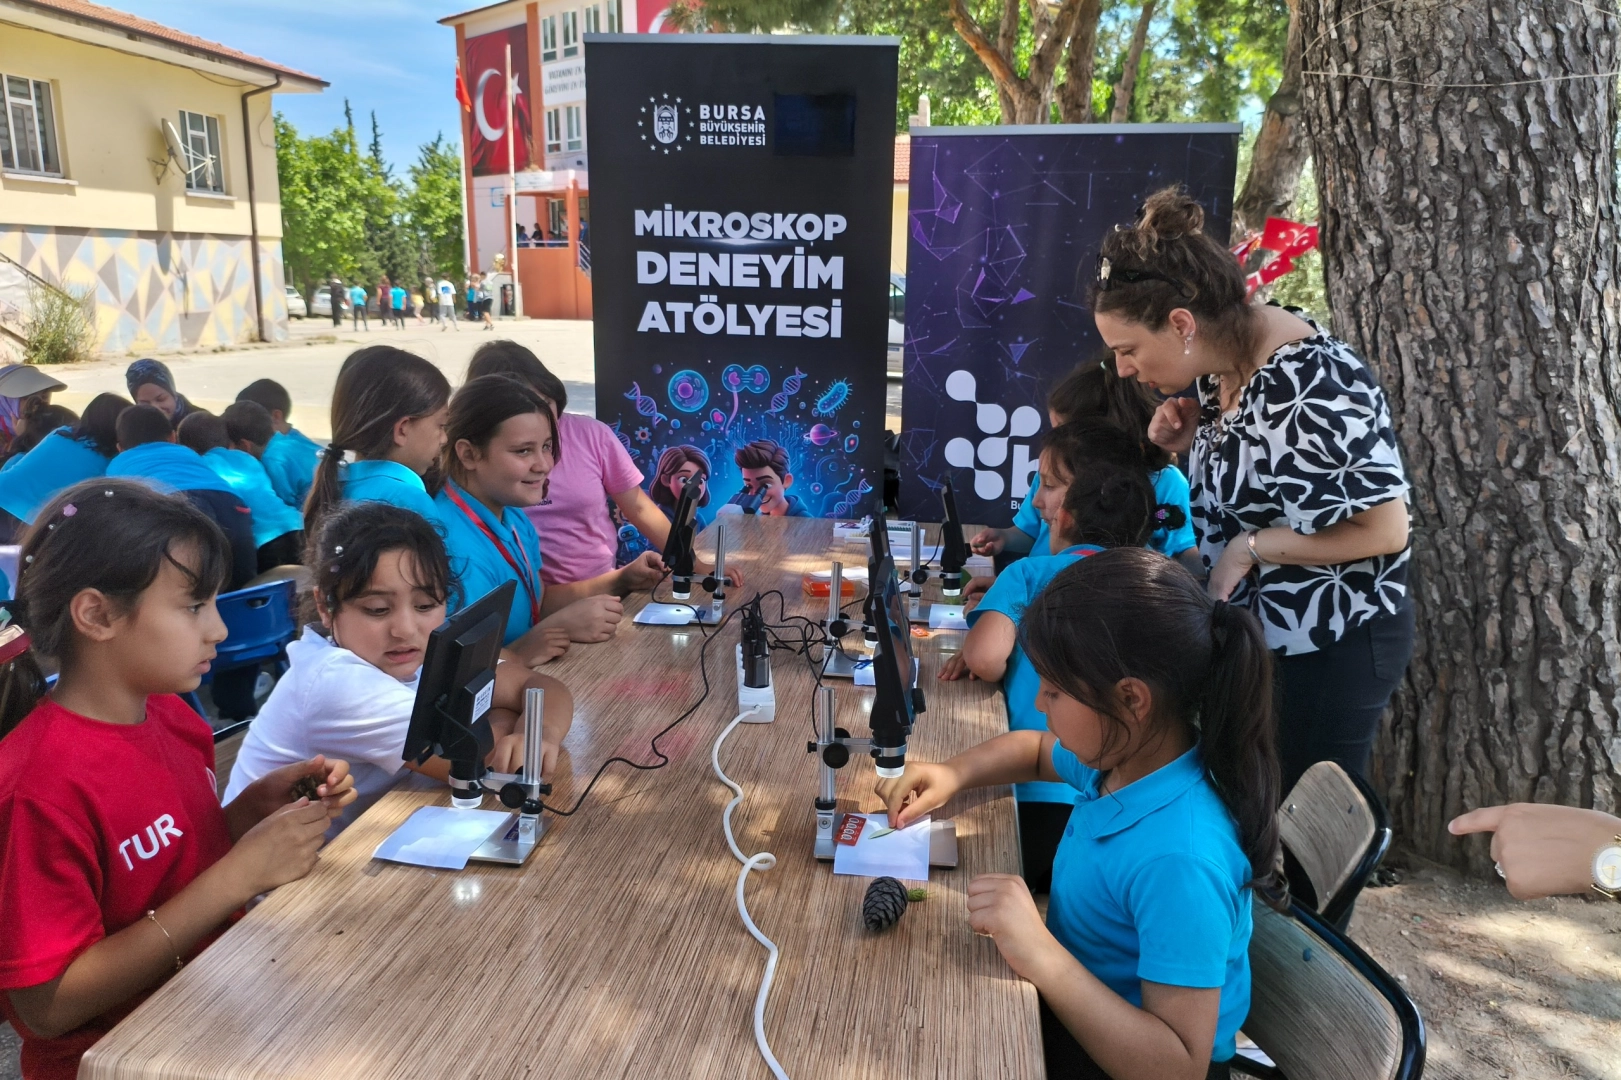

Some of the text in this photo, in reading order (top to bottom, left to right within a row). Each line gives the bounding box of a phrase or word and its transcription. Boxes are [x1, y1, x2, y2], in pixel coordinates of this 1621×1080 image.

[699, 104, 766, 121] BURSA
[699, 119, 766, 136] BÜYÜKŞEHİR
[699, 132, 766, 146] BELEDİYESİ
[634, 203, 848, 241] MİKROSKOP
[636, 246, 844, 290] DENEYİM
[636, 294, 843, 339] ATÖLYESİ
[119, 813, 184, 872] TUR
